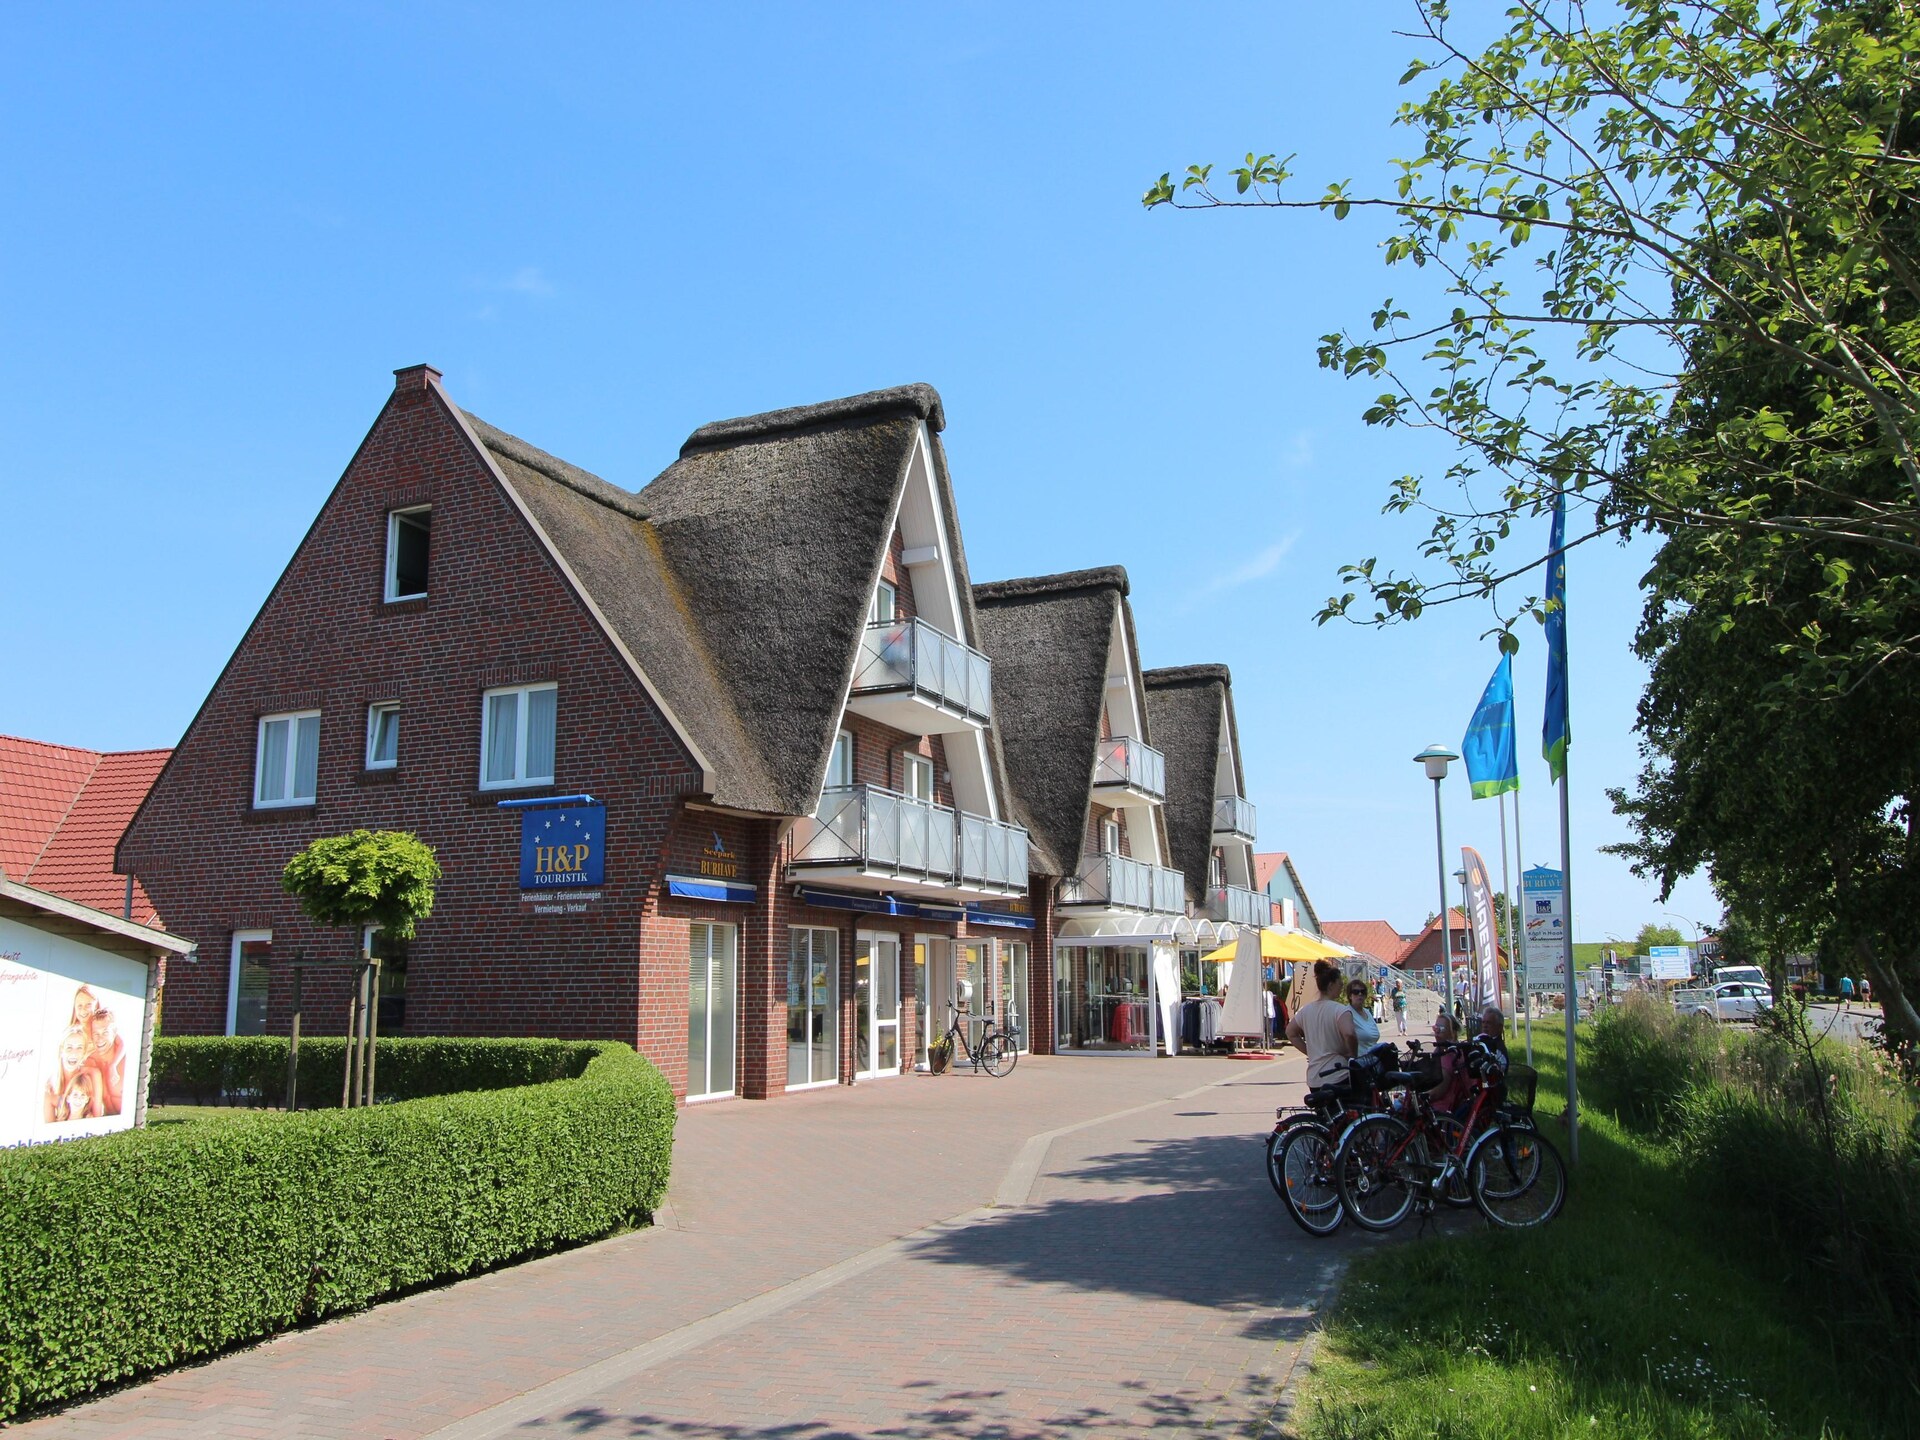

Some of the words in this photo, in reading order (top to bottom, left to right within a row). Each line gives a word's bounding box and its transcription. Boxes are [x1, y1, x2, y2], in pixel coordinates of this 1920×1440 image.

[535, 844, 590, 873] H&P
[703, 847, 736, 859] Seepark
[700, 860, 737, 877] BURHAVE
[534, 872, 588, 884] TOURISTIK
[521, 892, 554, 902] Ferienhäuser
[557, 891, 602, 901] Ferienwohnungen
[534, 904, 563, 915] Vermietung
[566, 902, 587, 912] Verkauf
